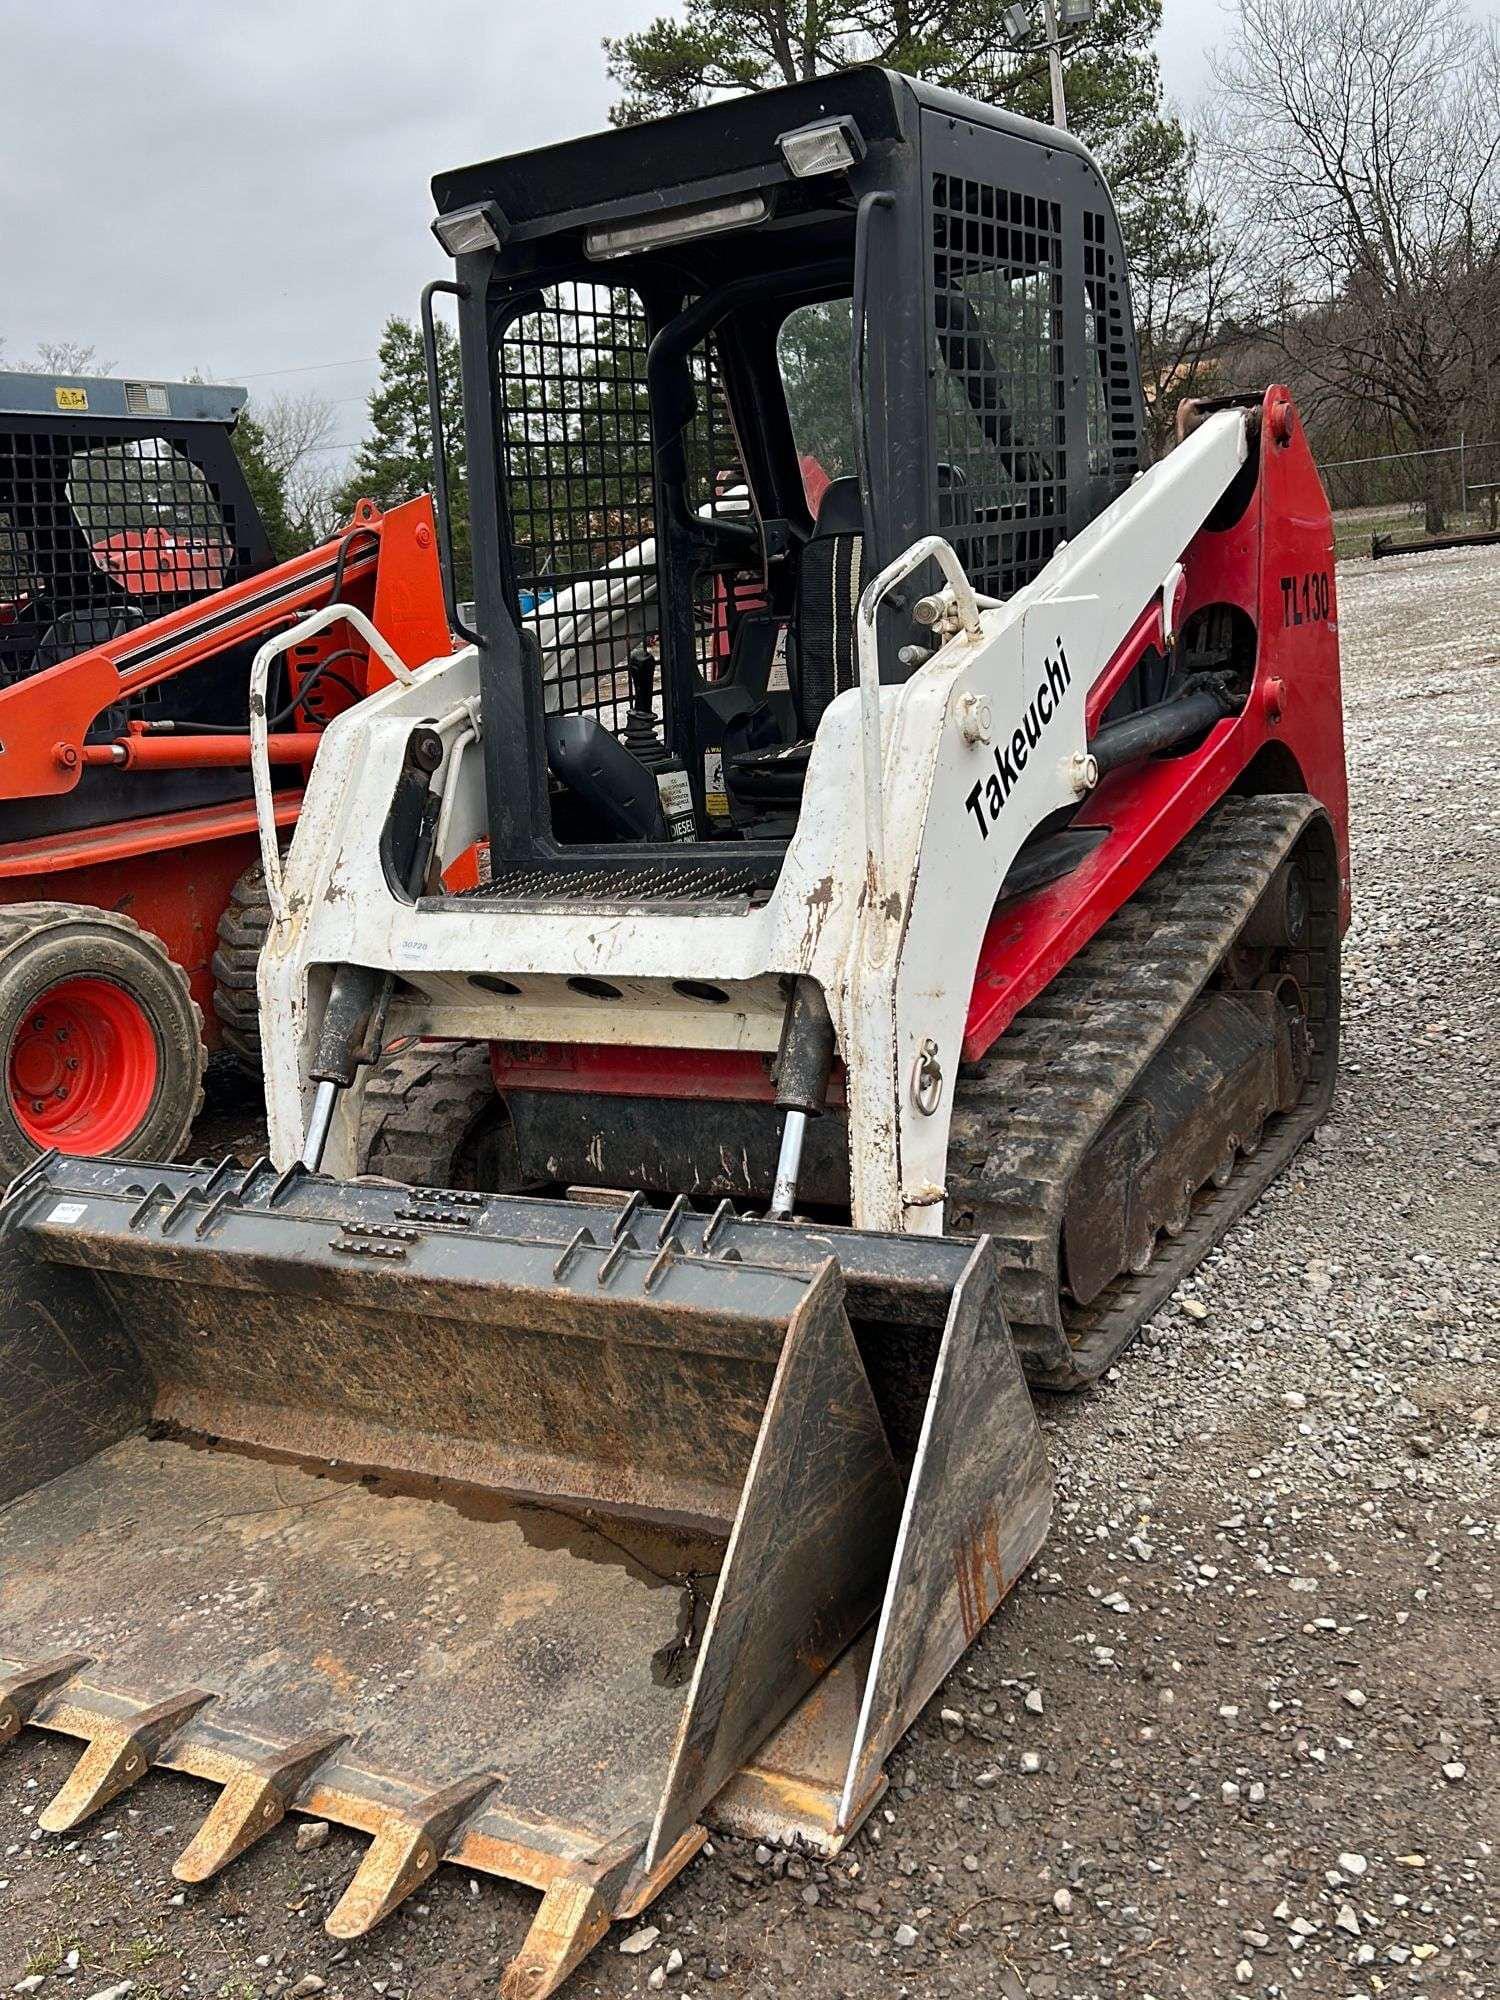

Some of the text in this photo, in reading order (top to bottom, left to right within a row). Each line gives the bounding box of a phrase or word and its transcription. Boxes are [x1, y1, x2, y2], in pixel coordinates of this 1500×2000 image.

[1280, 572, 1329, 628] TL130
[965, 636, 1071, 840] Takeuchi
[671, 819, 695, 838] DIESEL
